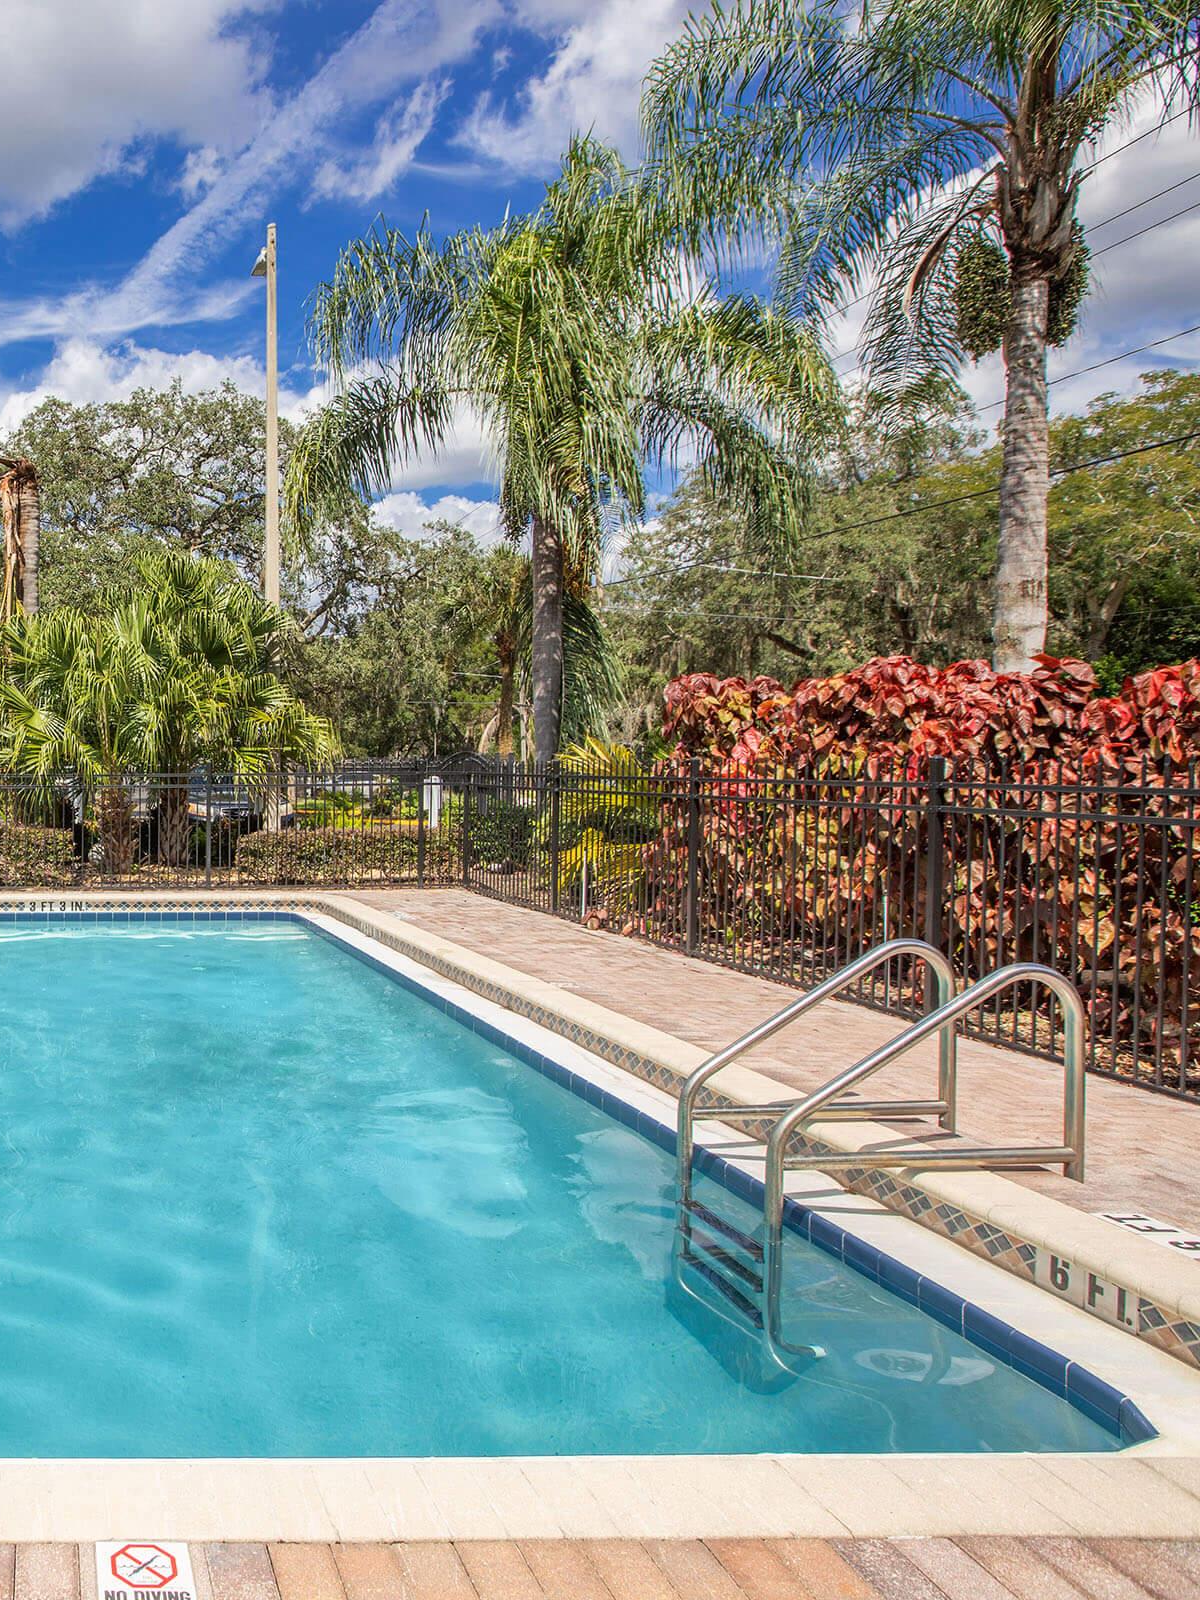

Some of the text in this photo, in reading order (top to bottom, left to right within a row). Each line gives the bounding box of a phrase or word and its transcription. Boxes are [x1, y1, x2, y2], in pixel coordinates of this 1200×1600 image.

[29, 902, 36, 912] 3
[60, 902, 66, 912] 3
[1050, 1254, 1070, 1291] 6
[104, 1590, 128, 1600] NO
